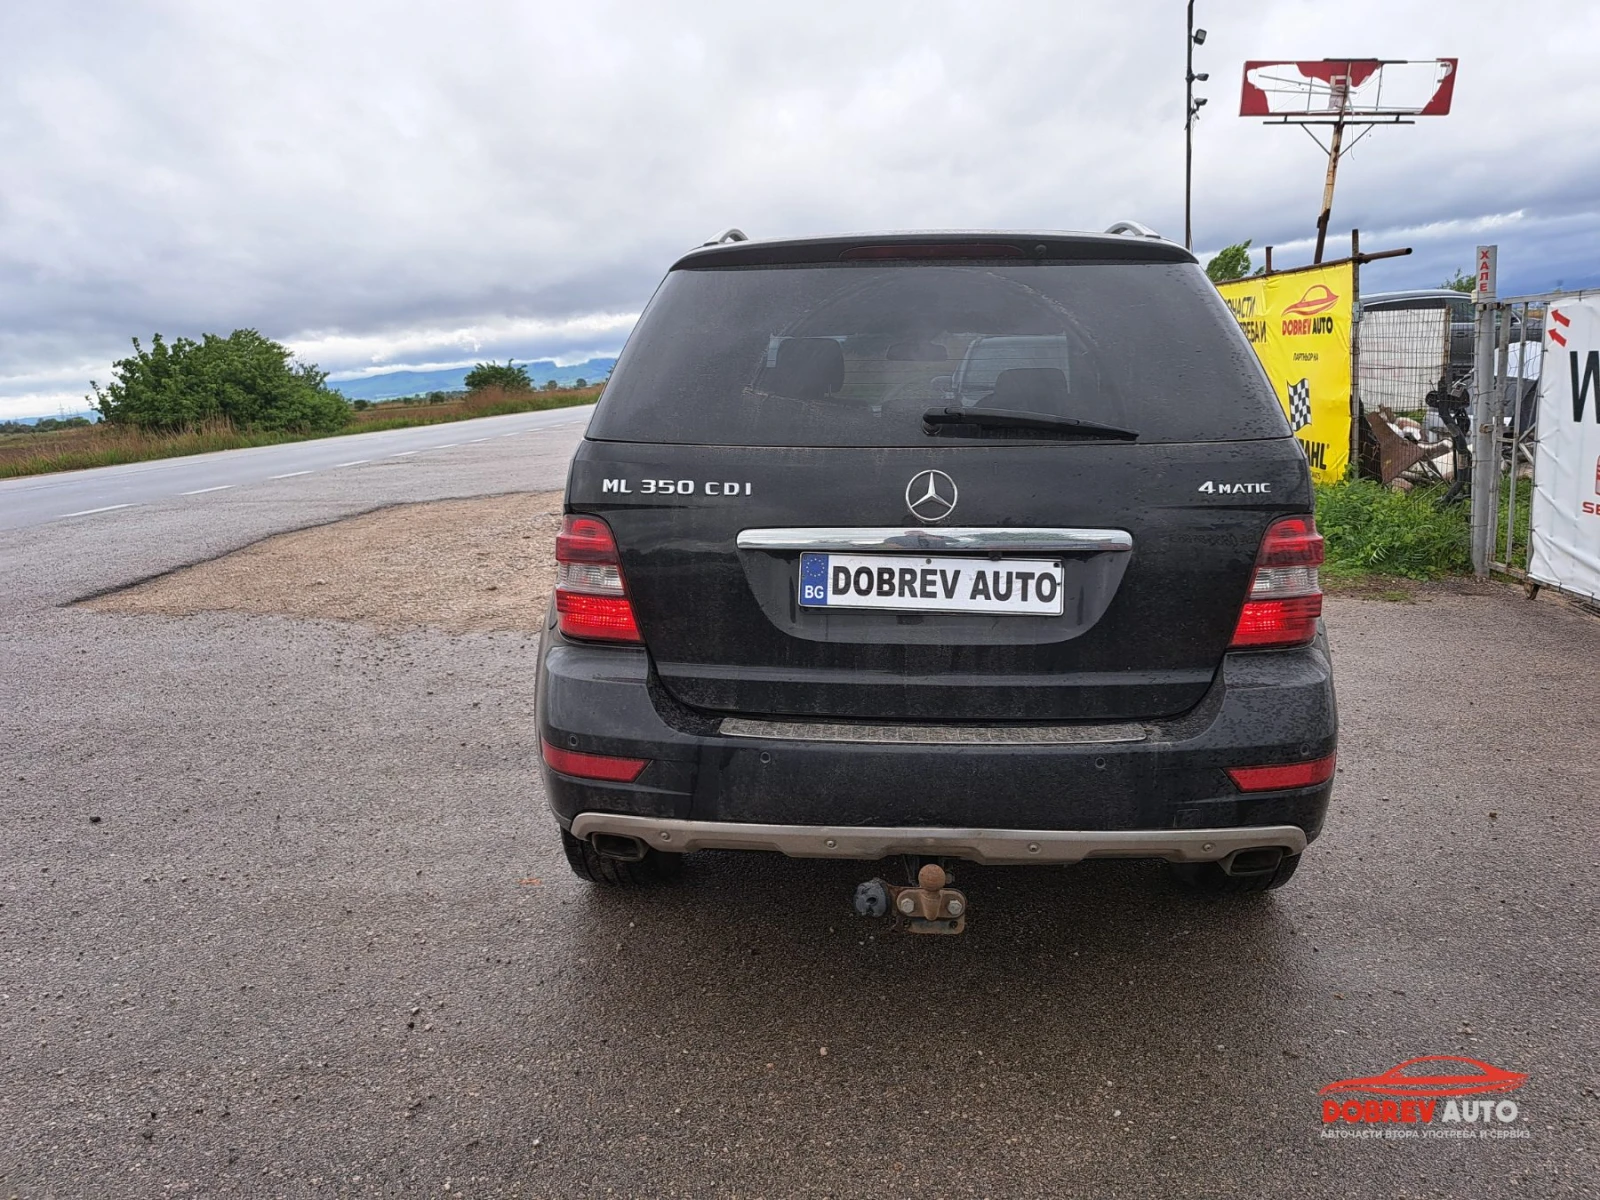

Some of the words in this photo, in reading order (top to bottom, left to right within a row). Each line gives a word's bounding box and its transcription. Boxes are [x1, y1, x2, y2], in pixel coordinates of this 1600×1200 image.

[1477, 250, 1489, 291] ХАЛЕ
[1225, 296, 1256, 318] ОЧАСТИ
[1282, 319, 1311, 336] DOBREV
[1312, 317, 1333, 334] AUTO
[602, 478, 633, 493] ML
[640, 479, 695, 495] 350
[705, 482, 752, 496] CDI
[804, 585, 825, 599] BG
[832, 565, 961, 599] DOBREV
[969, 570, 1058, 603] AUTO
